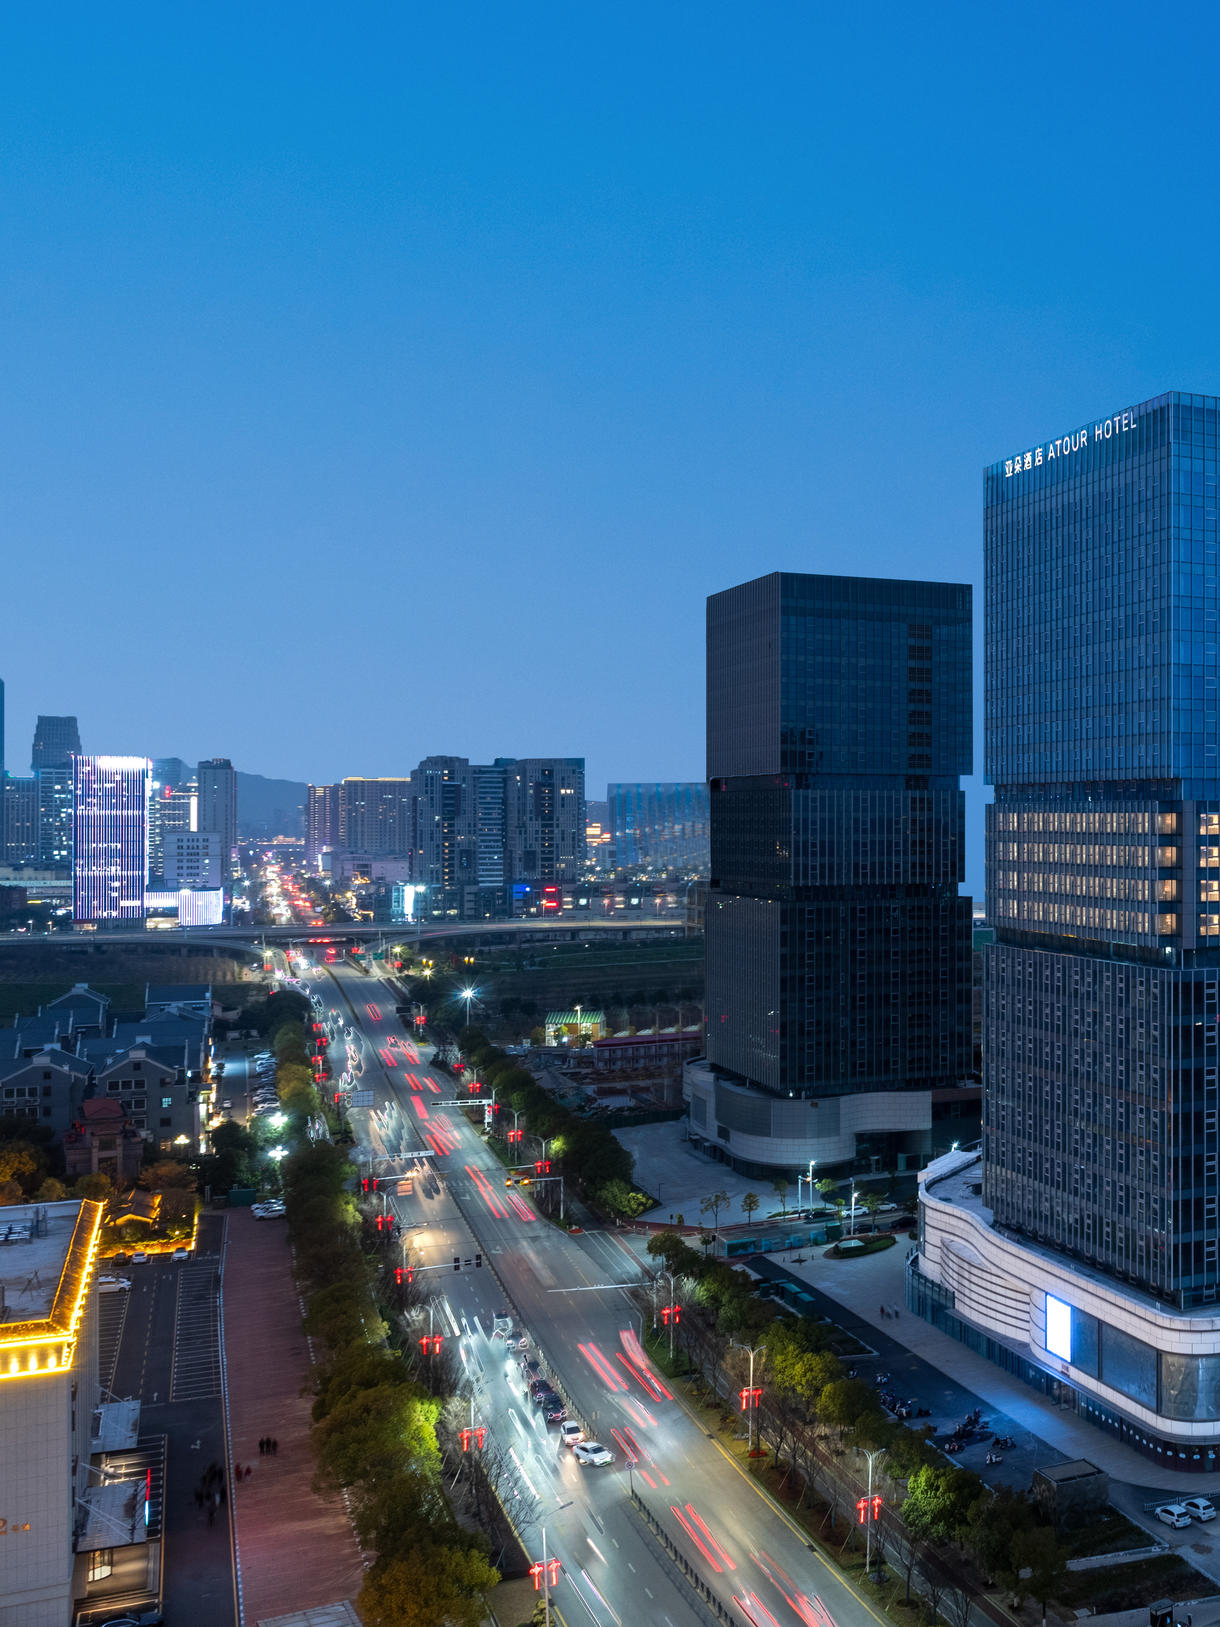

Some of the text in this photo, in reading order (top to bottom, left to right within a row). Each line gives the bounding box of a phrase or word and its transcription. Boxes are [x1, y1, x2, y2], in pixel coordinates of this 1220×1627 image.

[1047, 411, 1137, 461] ATOUR HOTEL
[1005, 447, 1043, 477] 亚朵酒店
